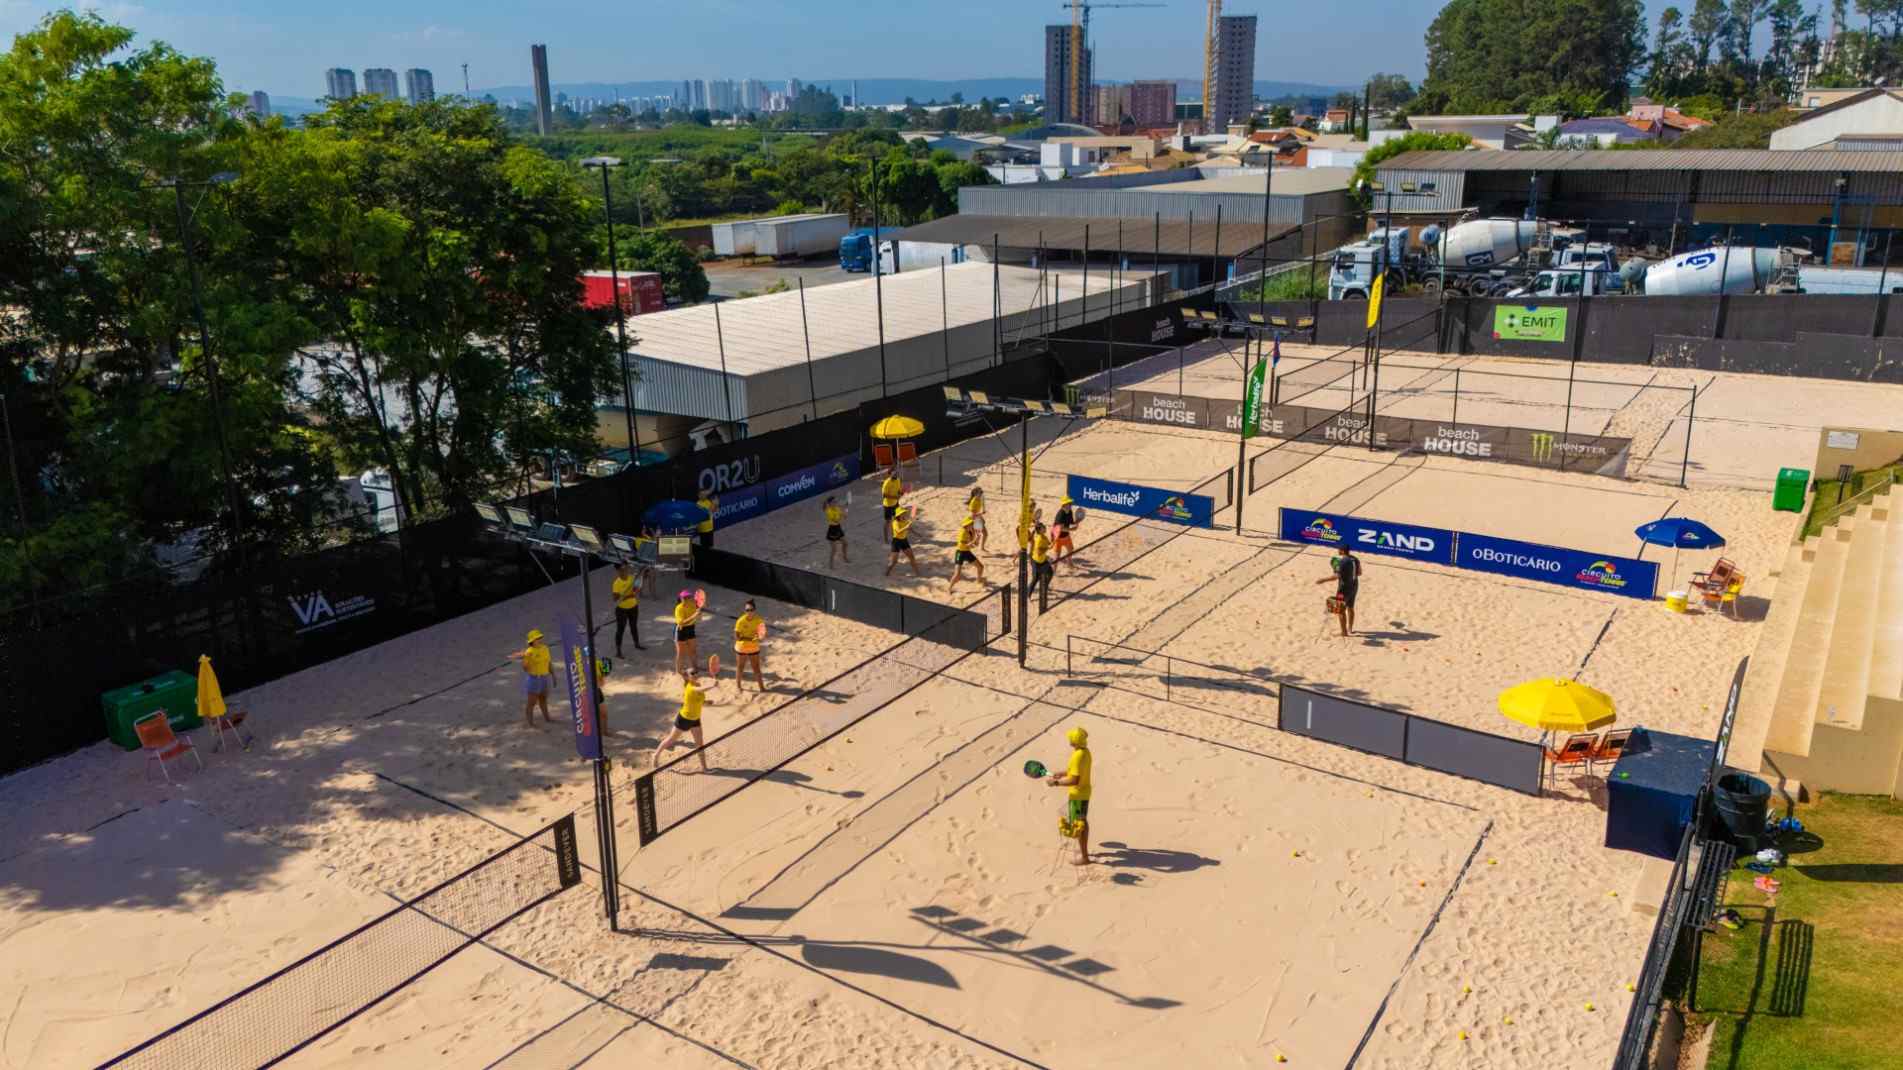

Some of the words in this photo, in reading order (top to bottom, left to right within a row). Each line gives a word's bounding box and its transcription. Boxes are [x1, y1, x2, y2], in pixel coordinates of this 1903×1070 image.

[1521, 316, 1560, 328] EMIT
[1152, 396, 1186, 409] beach
[1143, 407, 1196, 424] HOUSE
[1438, 426, 1480, 440] beach
[1424, 437, 1492, 456] HOUSE
[699, 453, 761, 493] OR2U
[1083, 486, 1136, 507] Herbalife
[1357, 528, 1436, 552] ZAND
